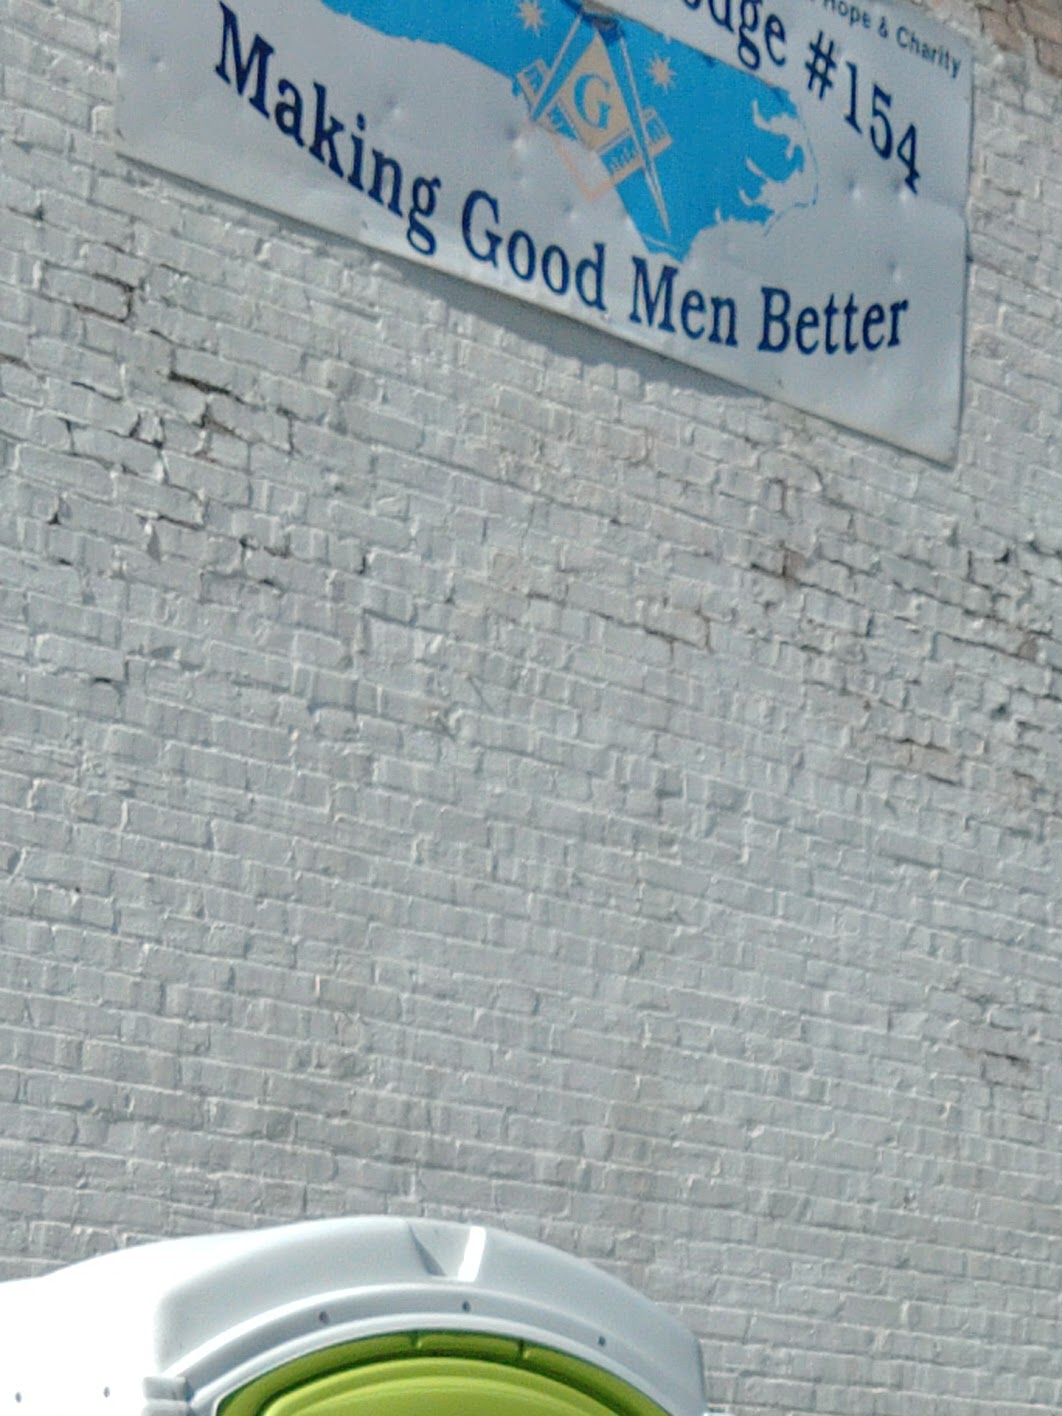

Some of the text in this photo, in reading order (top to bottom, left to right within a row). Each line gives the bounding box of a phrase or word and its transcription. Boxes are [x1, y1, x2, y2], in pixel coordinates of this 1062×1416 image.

[573, 73, 612, 130] G
[878, 16, 889, 39] &
[896, 26, 962, 78] Charity
[805, 30, 921, 194] #154
[214, 1, 909, 355] Making Good Men Better
